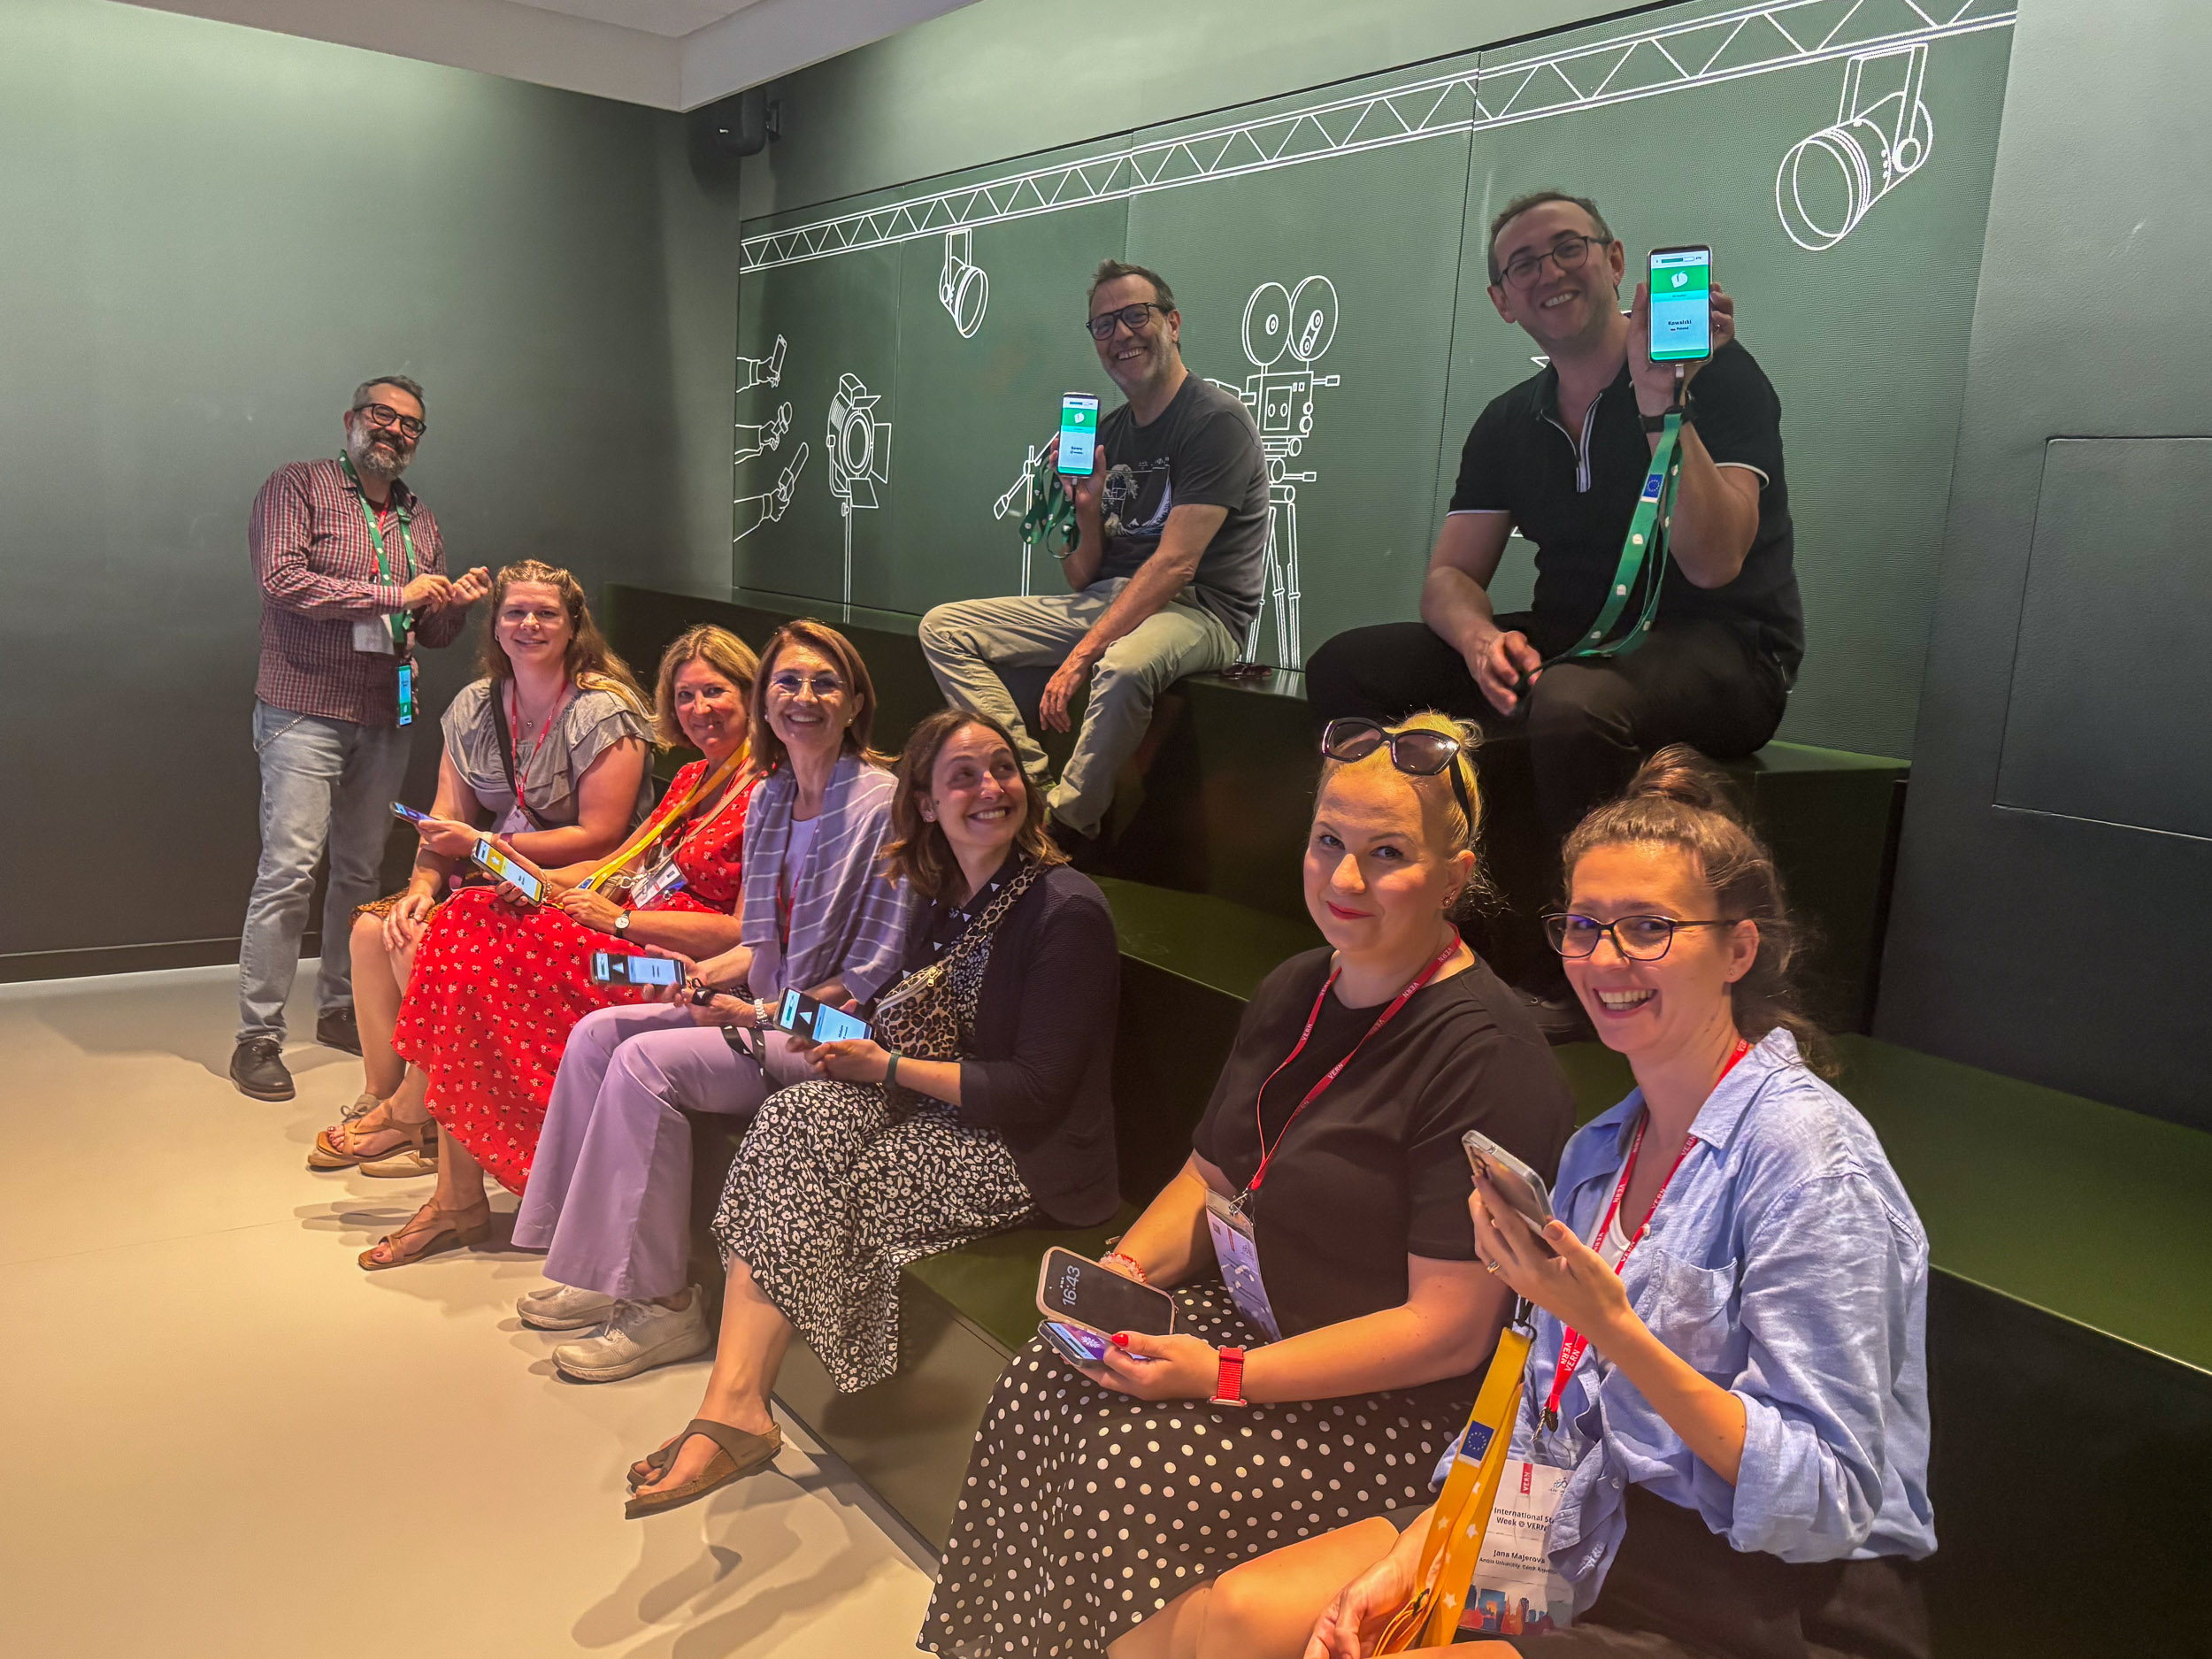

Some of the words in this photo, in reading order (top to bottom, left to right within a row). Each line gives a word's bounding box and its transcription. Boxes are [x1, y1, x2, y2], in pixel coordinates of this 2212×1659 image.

[1437, 947, 1454, 963] VERN
[1402, 982, 1419, 998] VERN
[1301, 1022, 1313, 1041] VERN
[1327, 1063, 1344, 1079] VERN
[1681, 1135, 1696, 1156] VERN
[1613, 1183, 1626, 1203] VERN
[1063, 1265, 1079, 1305] 16:43
[1561, 1342, 1572, 1364] VERN
[1494, 1508, 1543, 1522] International
[1496, 1517, 1517, 1526] Week
